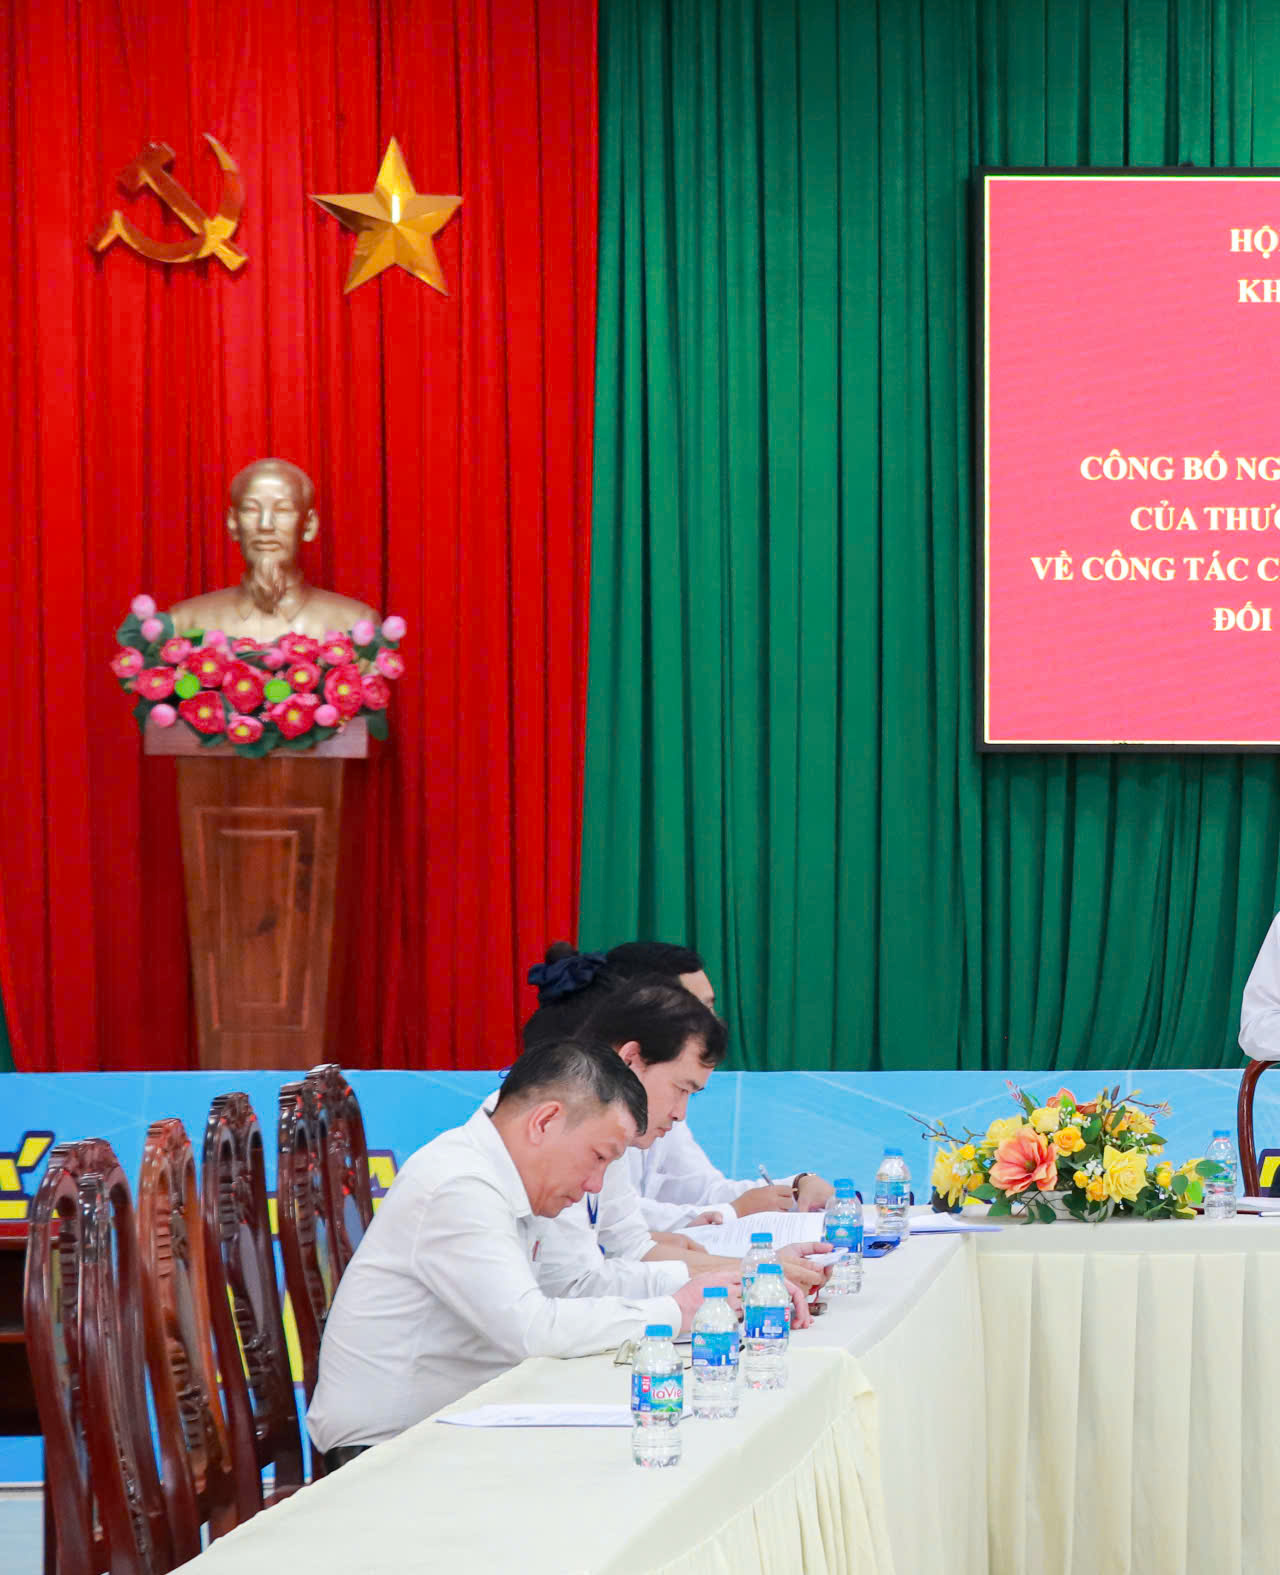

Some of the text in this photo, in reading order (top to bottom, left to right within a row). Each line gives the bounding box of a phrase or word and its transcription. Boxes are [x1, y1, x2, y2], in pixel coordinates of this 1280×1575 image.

[1079, 448, 1175, 481] CÔNG
[1182, 449, 1229, 481] BỐ
[1129, 499, 1199, 532] CỦA
[1029, 549, 1075, 581] VỀ
[1081, 548, 1177, 582] CÔNG
[1182, 549, 1250, 582] TÁC
[1212, 600, 1273, 632] ĐỐI
